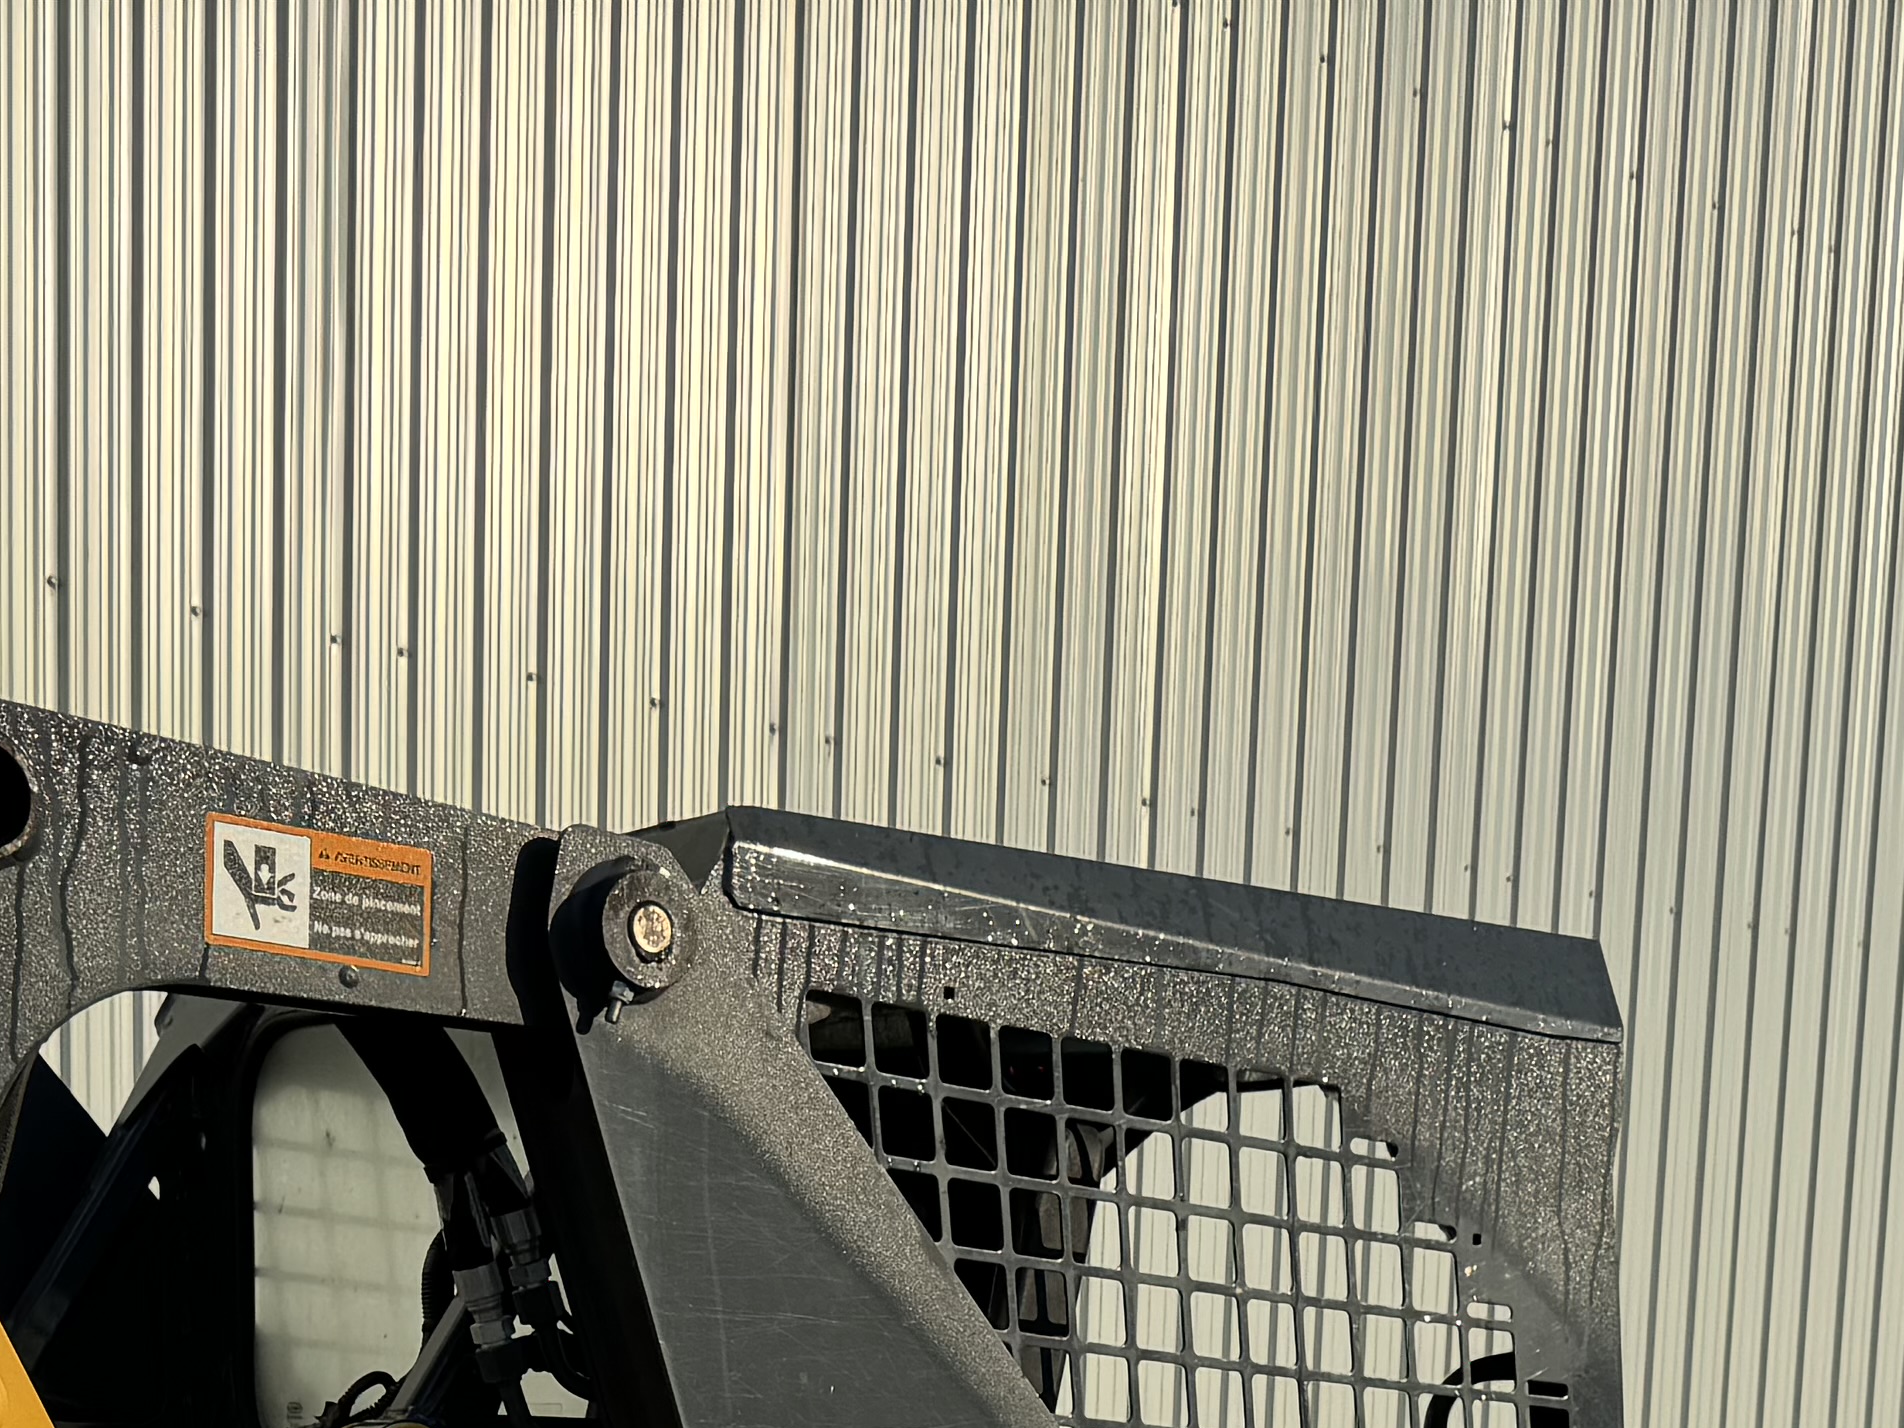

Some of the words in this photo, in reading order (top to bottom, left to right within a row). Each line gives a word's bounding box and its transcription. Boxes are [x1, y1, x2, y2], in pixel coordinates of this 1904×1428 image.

[312, 886, 342, 903] Zone
[345, 892, 359, 905] de
[362, 894, 421, 916] pincement
[314, 920, 330, 935] Ne
[332, 925, 352, 938] pas
[354, 927, 419, 949] s'approcher
